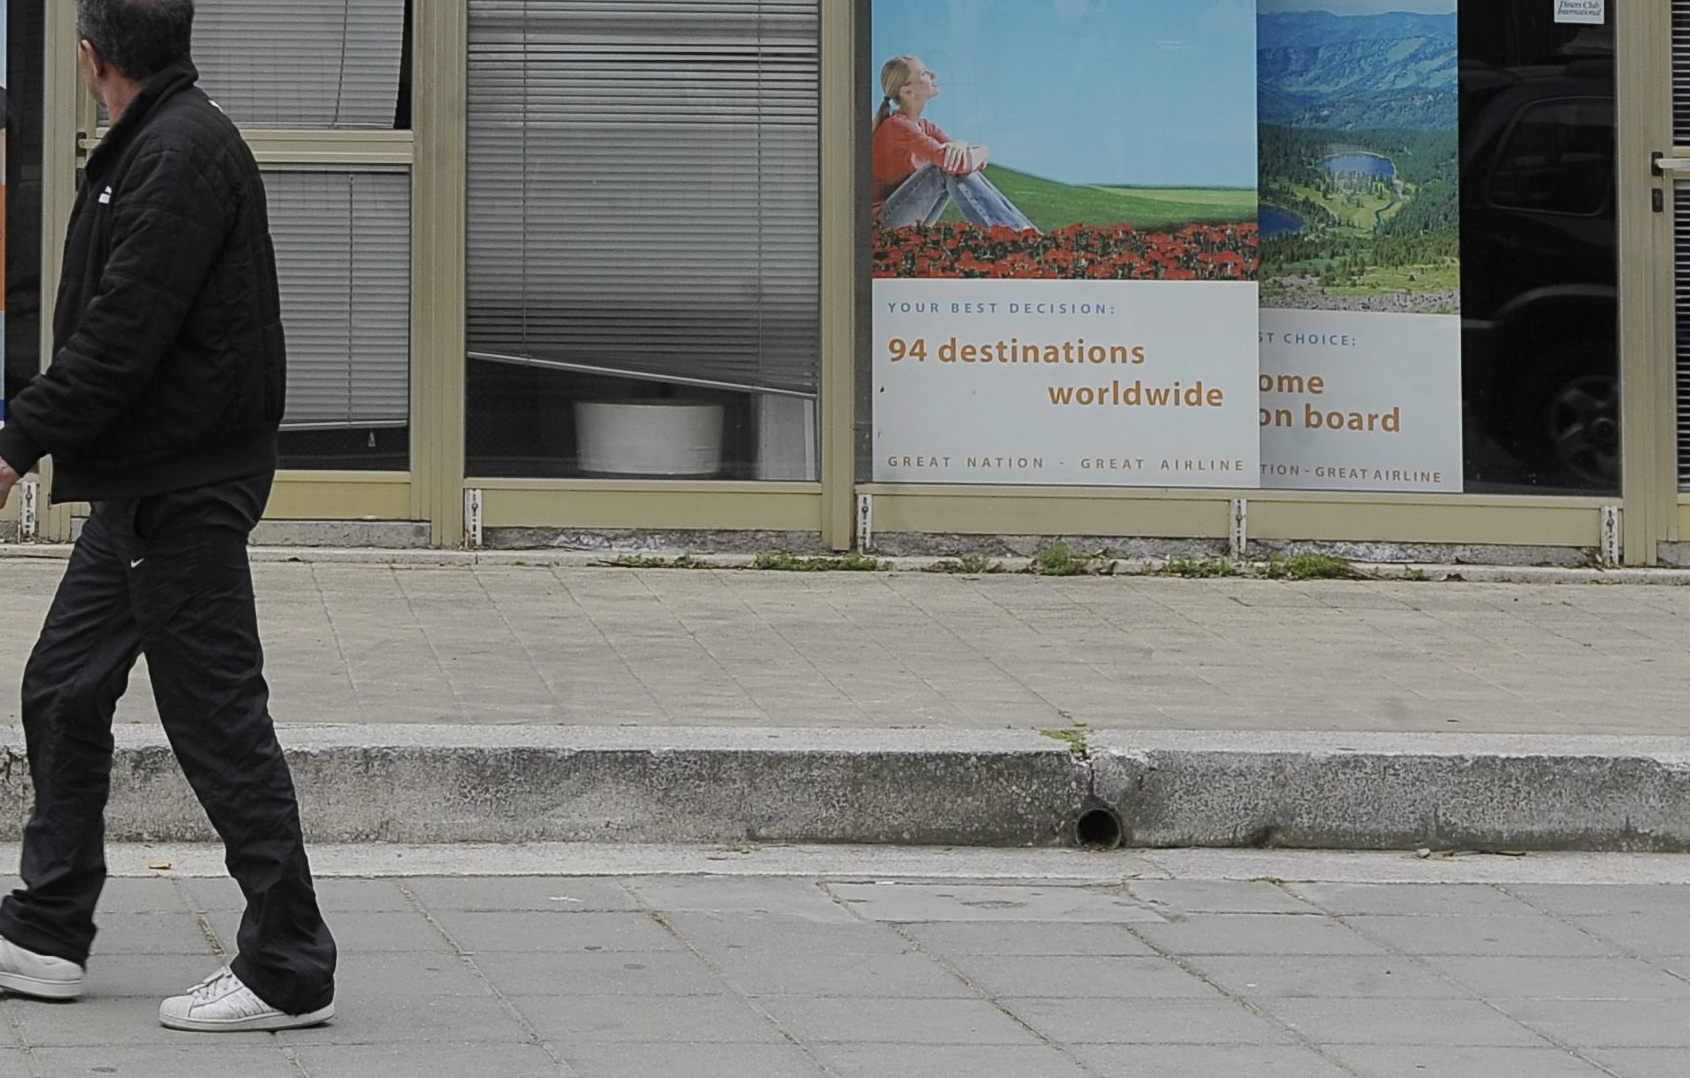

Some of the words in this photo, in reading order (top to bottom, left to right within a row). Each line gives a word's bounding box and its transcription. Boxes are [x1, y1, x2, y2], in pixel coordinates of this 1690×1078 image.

[1583, 0, 1600, 10] Club
[887, 302, 940, 314] YOUR
[951, 302, 998, 314] BEST
[1009, 302, 1115, 315] DECISION:
[1258, 332, 1275, 344] ST
[1283, 333, 1356, 347] CHOICE:
[888, 338, 927, 363] 94
[937, 337, 1146, 364] destinations
[1047, 380, 1225, 408] worldwide
[1259, 373, 1325, 395] ome
[1259, 407, 1293, 427] on
[1304, 402, 1401, 433] board
[887, 455, 952, 468] GREAT
[966, 456, 1044, 469] NATION
[1080, 457, 1146, 470] GREAT
[1160, 458, 1245, 471] AIRLINE
[1259, 463, 1300, 476] TION
[1315, 466, 1368, 479] GREAT
[1373, 469, 1442, 483] AIRLINE
